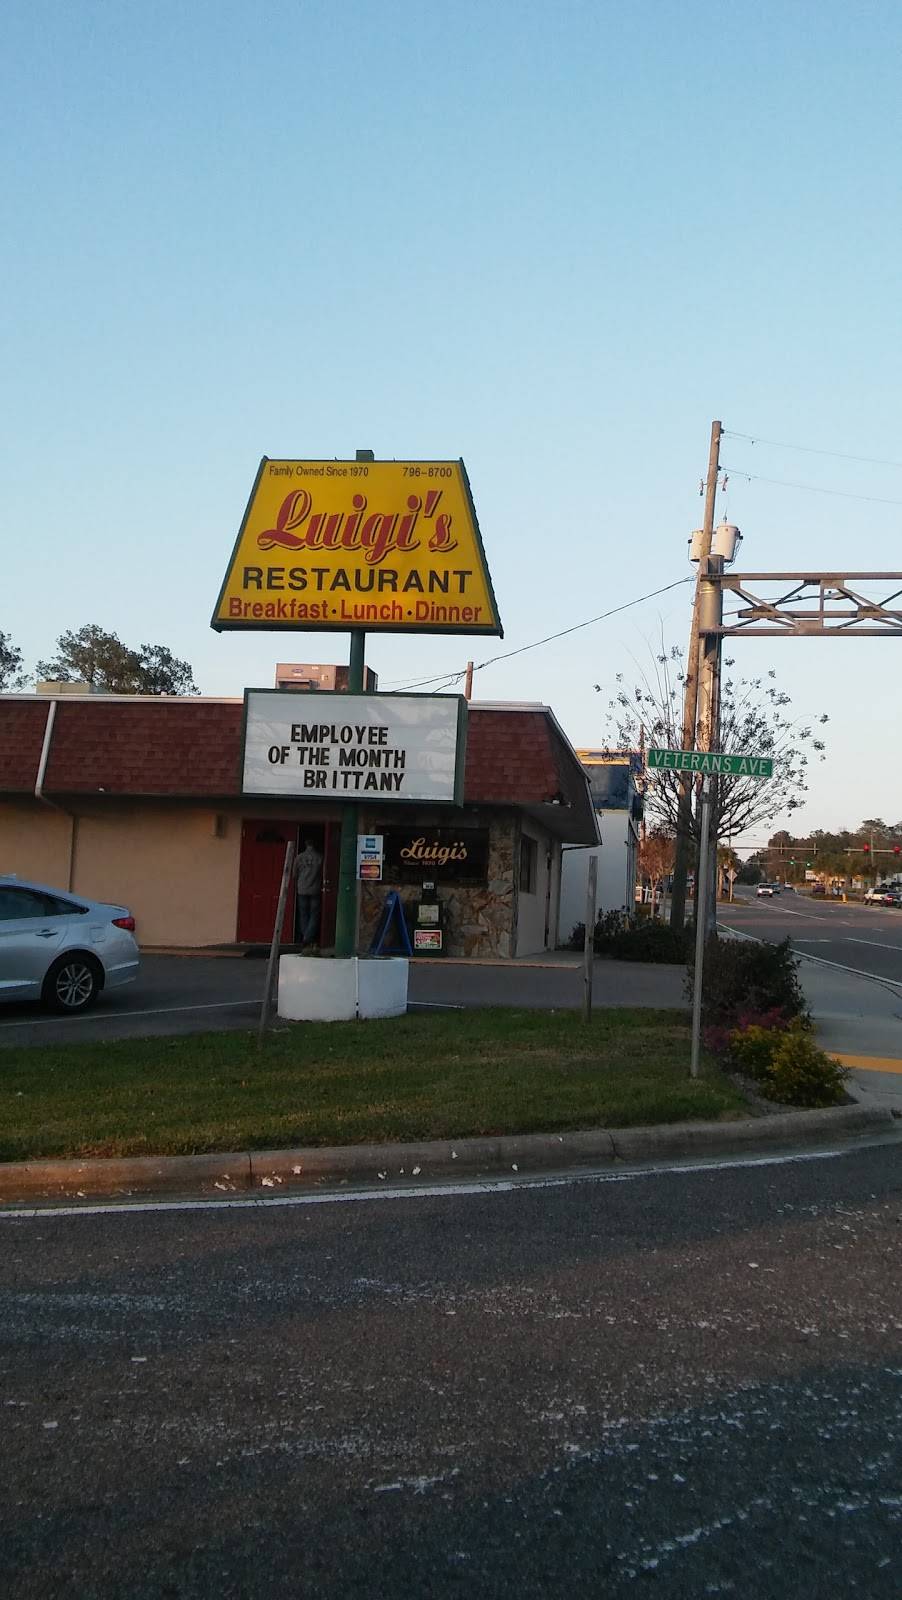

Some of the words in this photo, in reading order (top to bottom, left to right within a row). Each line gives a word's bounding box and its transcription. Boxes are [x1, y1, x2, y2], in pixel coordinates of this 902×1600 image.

[269, 465, 294, 478] Family
[296, 466, 325, 477] Owned
[326, 466, 348, 477] Since
[350, 467, 369, 477] 1970
[402, 467, 452, 477] 796-8700
[257, 489, 457, 564] Luigi's
[243, 567, 472, 593] RESTAURANT
[229, 597, 328, 620] Breakfast
[341, 600, 402, 620] Lunch
[415, 601, 482, 622] Dinner
[291, 724, 388, 745] EMPLOYEE
[268, 746, 290, 764] OF
[297, 747, 330, 766] THE
[338, 748, 406, 768] MONTH
[654, 751, 731, 772] VETERANS
[738, 760, 768, 775] AVE
[304, 769, 404, 791] BRITTANY
